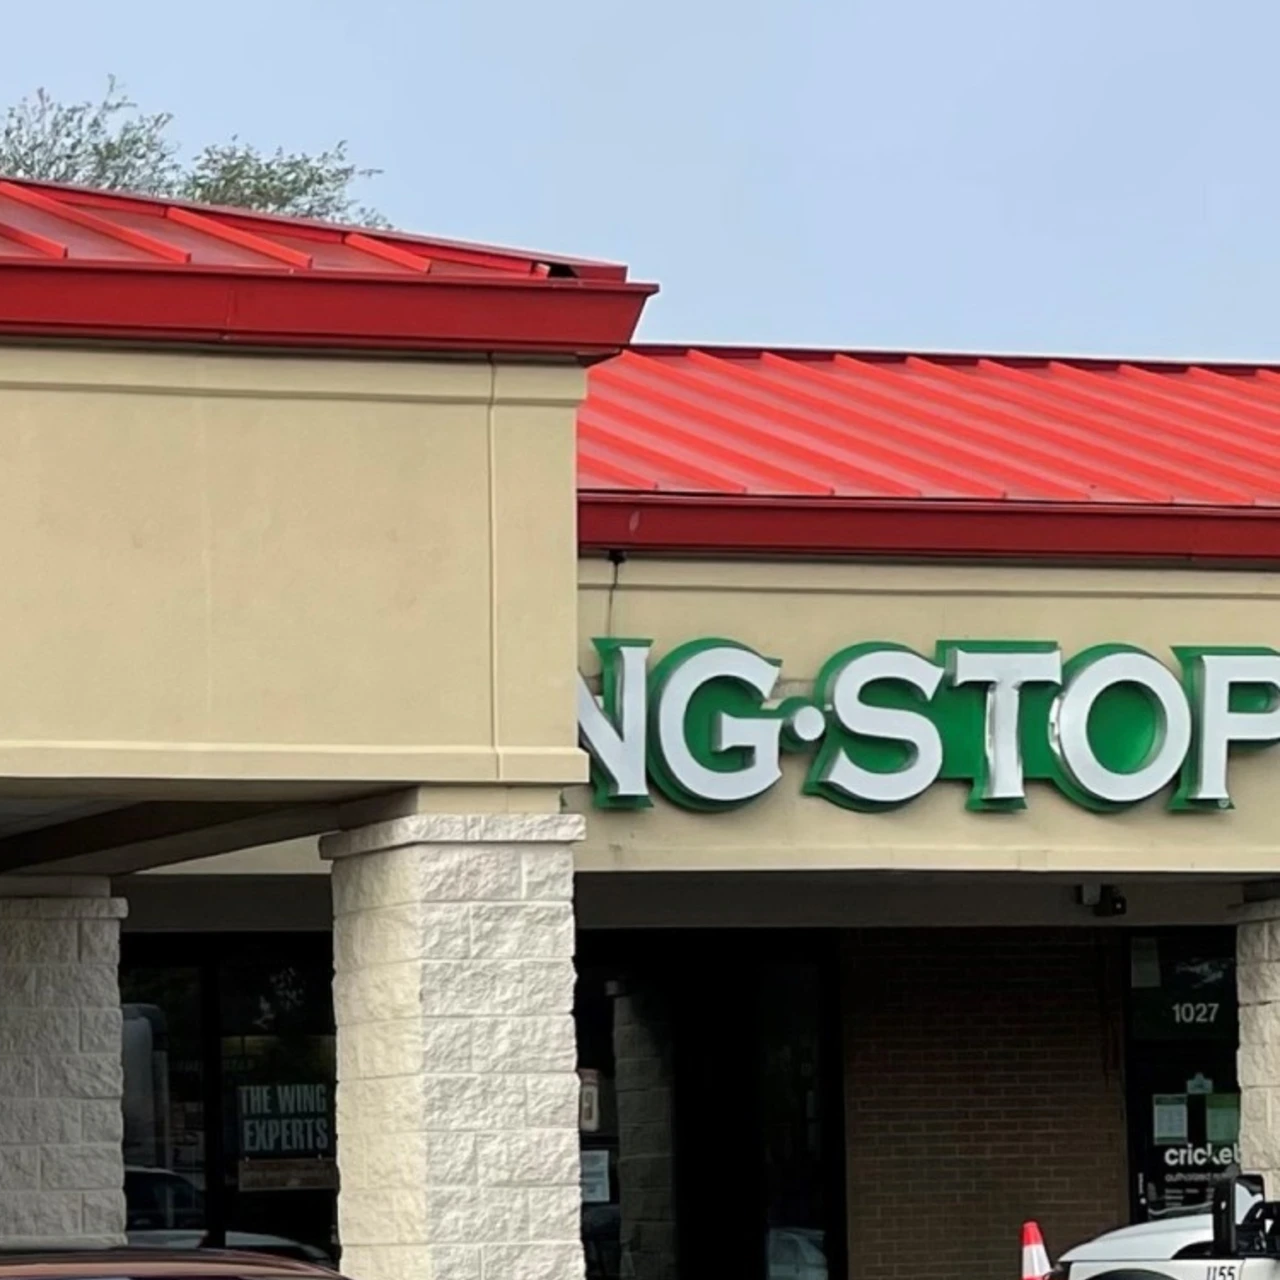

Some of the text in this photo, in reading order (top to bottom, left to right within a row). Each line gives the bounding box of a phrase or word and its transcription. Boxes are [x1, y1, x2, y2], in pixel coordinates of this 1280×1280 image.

[1171, 1003, 1219, 1024] 1027
[238, 1084, 328, 1115] THE WING
[243, 1118, 329, 1151] EXPERTS
